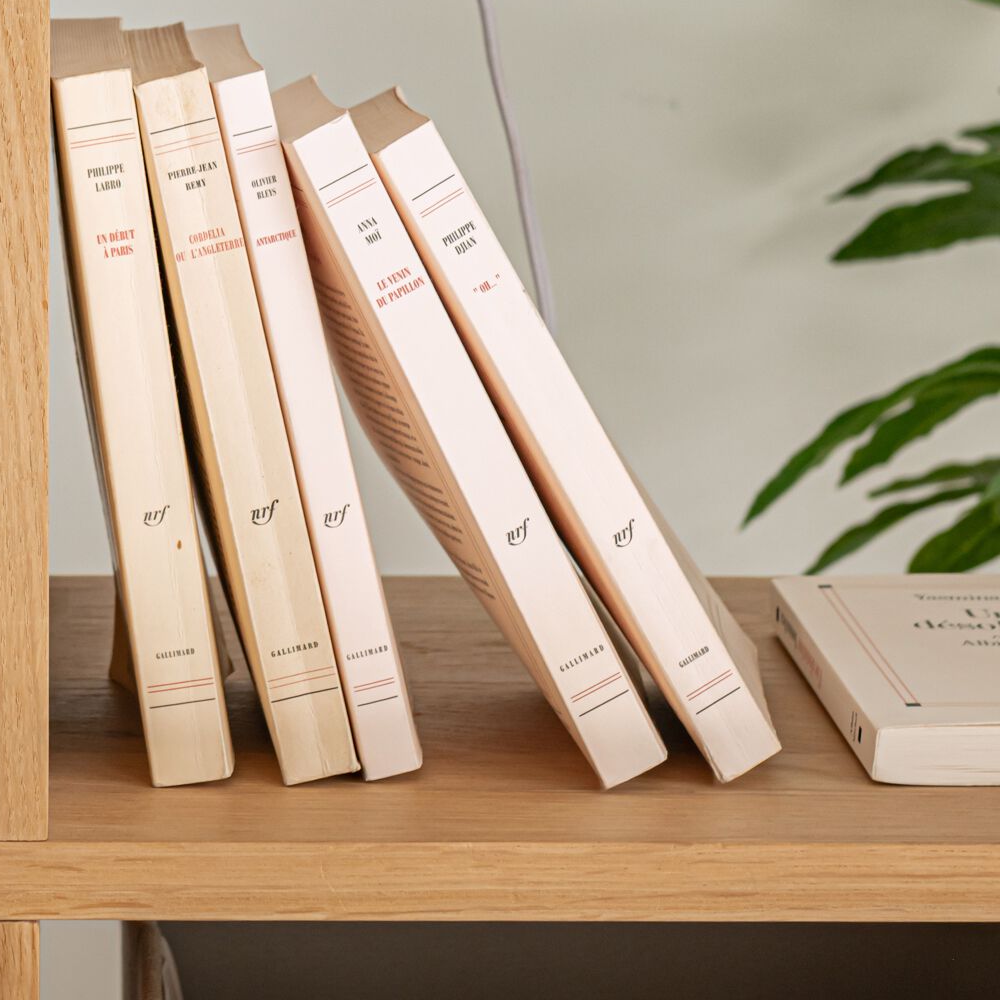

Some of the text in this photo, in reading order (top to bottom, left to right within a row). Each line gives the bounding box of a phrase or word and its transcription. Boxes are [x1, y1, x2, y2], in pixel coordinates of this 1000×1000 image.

[87, 163, 125, 179] PHILIPPE
[167, 161, 218, 181] PIERRE-JEAN
[95, 179, 122, 193] LABRO
[185, 178, 207, 191] REMY
[251, 175, 277, 189] OLIVIER
[256, 188, 277, 200] BLEYS
[357, 216, 378, 233] ANNA
[442, 220, 477, 247] PHILIPPE
[96, 228, 136, 245] UN DÉBUT
[188, 227, 226, 244] CORDELIA
[256, 229, 297, 247] ANTARCTIQUE
[103, 246, 134, 259] À PARIS
[191, 237, 245, 259] L'ANGLETERRE
[455, 236, 477, 255] DJIAN
[376, 266, 412, 291] LE VENIN
[376, 276, 426, 309] DU PAPILLON
[143, 505, 170, 527] nrf
[250, 499, 279, 526] nrf
[323, 503, 350, 528] nrf
[505, 517, 530, 546] nrf
[612, 518, 635, 548] nrf
[155, 647, 195, 660] GALLIMARD
[270, 641, 319, 658] GALLIMARD
[346, 645, 389, 661] GALLIMARD
[559, 644, 605, 673] GALLIMARD
[678, 645, 710, 669] GALLIMARD
